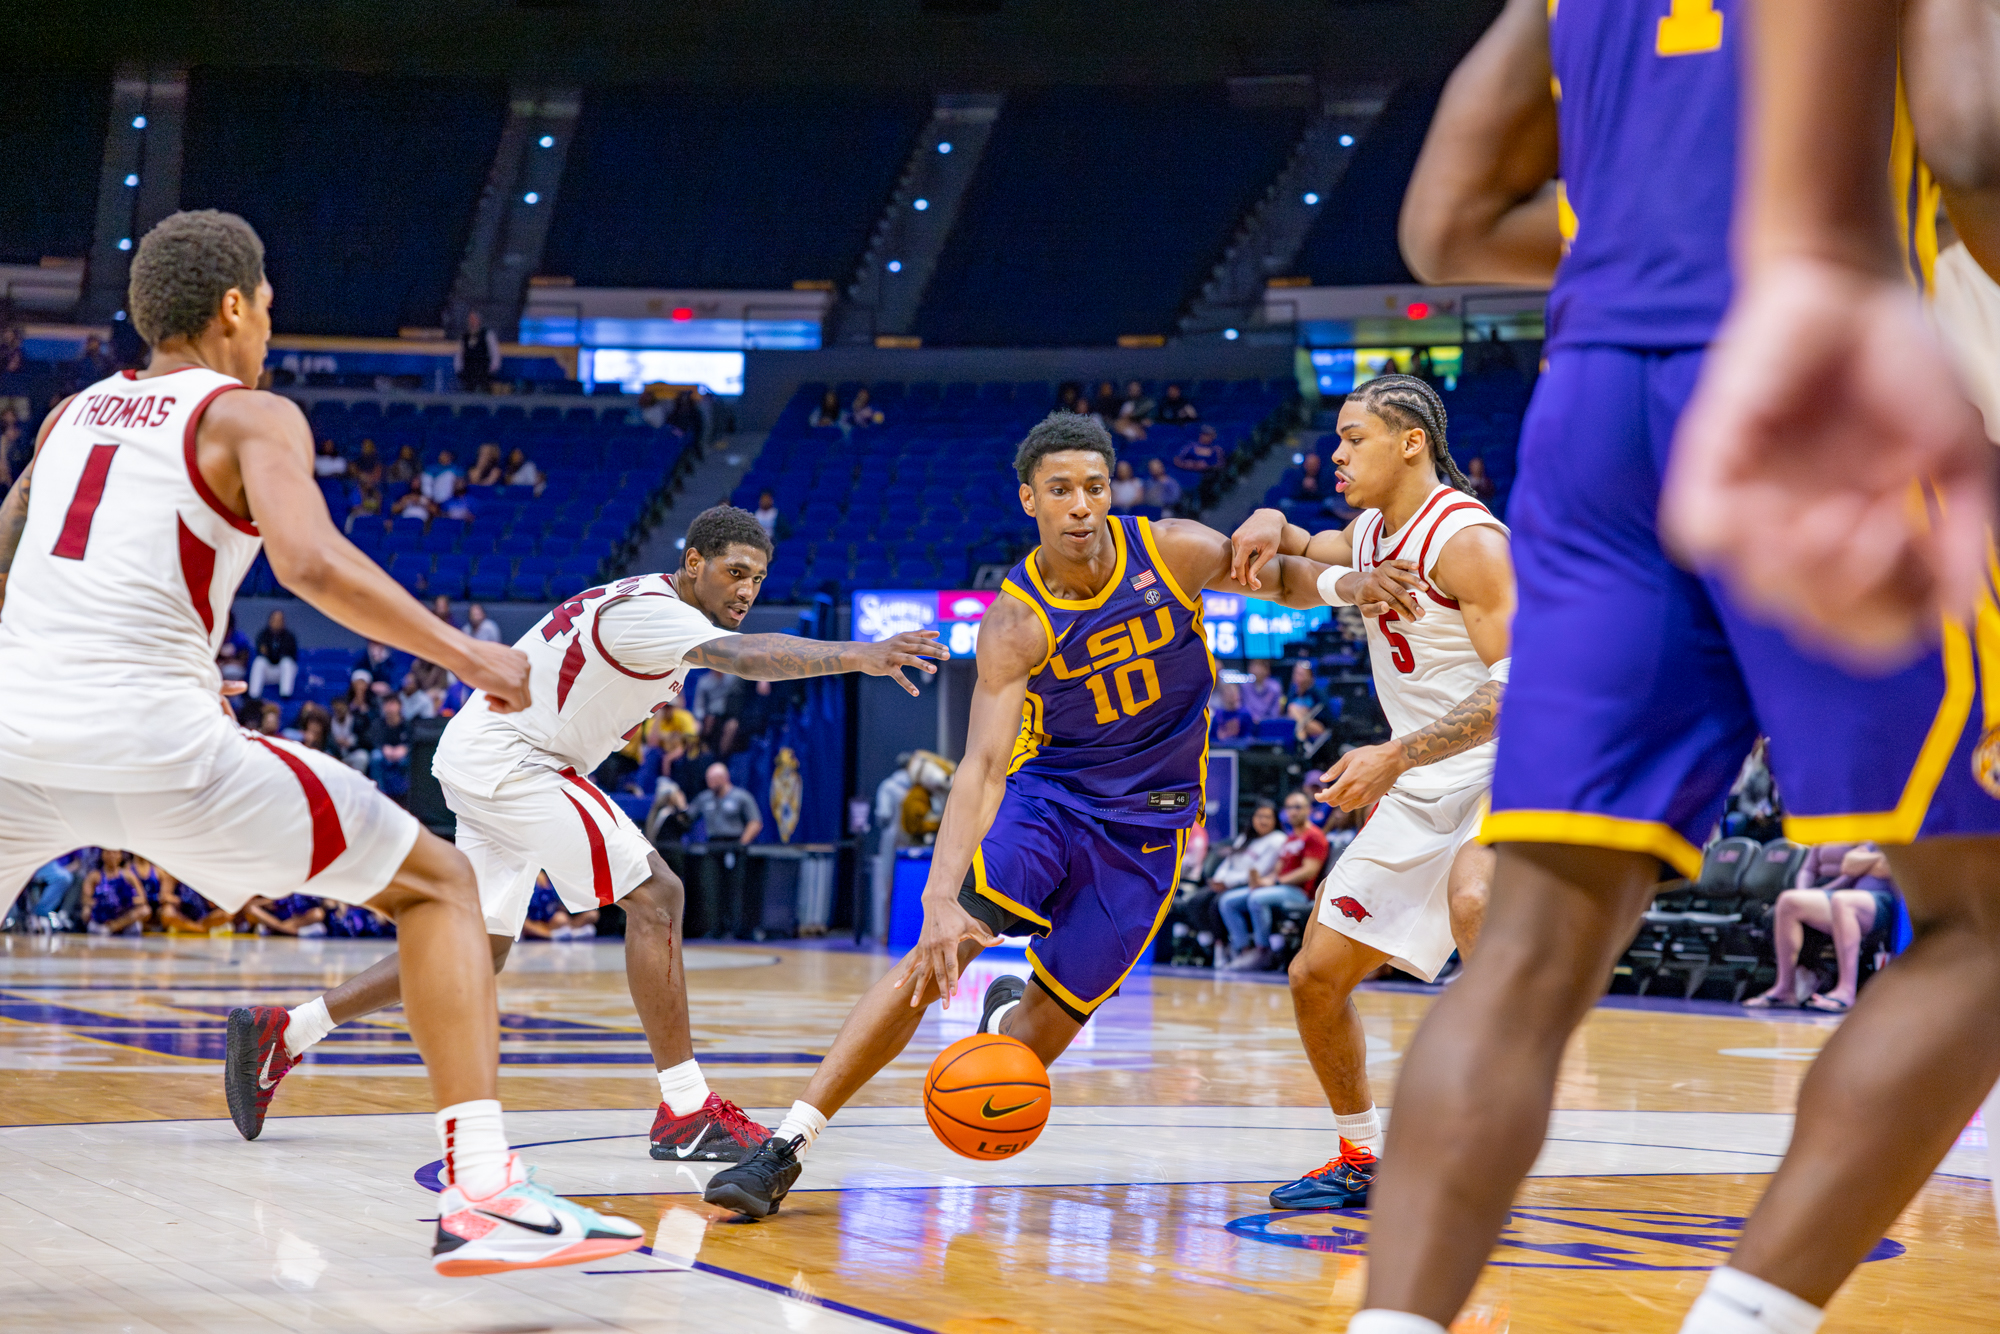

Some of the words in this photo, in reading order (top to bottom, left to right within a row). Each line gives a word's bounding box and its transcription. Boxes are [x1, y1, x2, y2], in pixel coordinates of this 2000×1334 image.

[73, 394, 177, 428] THOMAS
[50, 443, 120, 561] 1
[1049, 606, 1176, 680] LSU
[1378, 608, 1416, 674] 5
[1085, 657, 1162, 725] 10
[977, 1140, 1028, 1155] LSU
